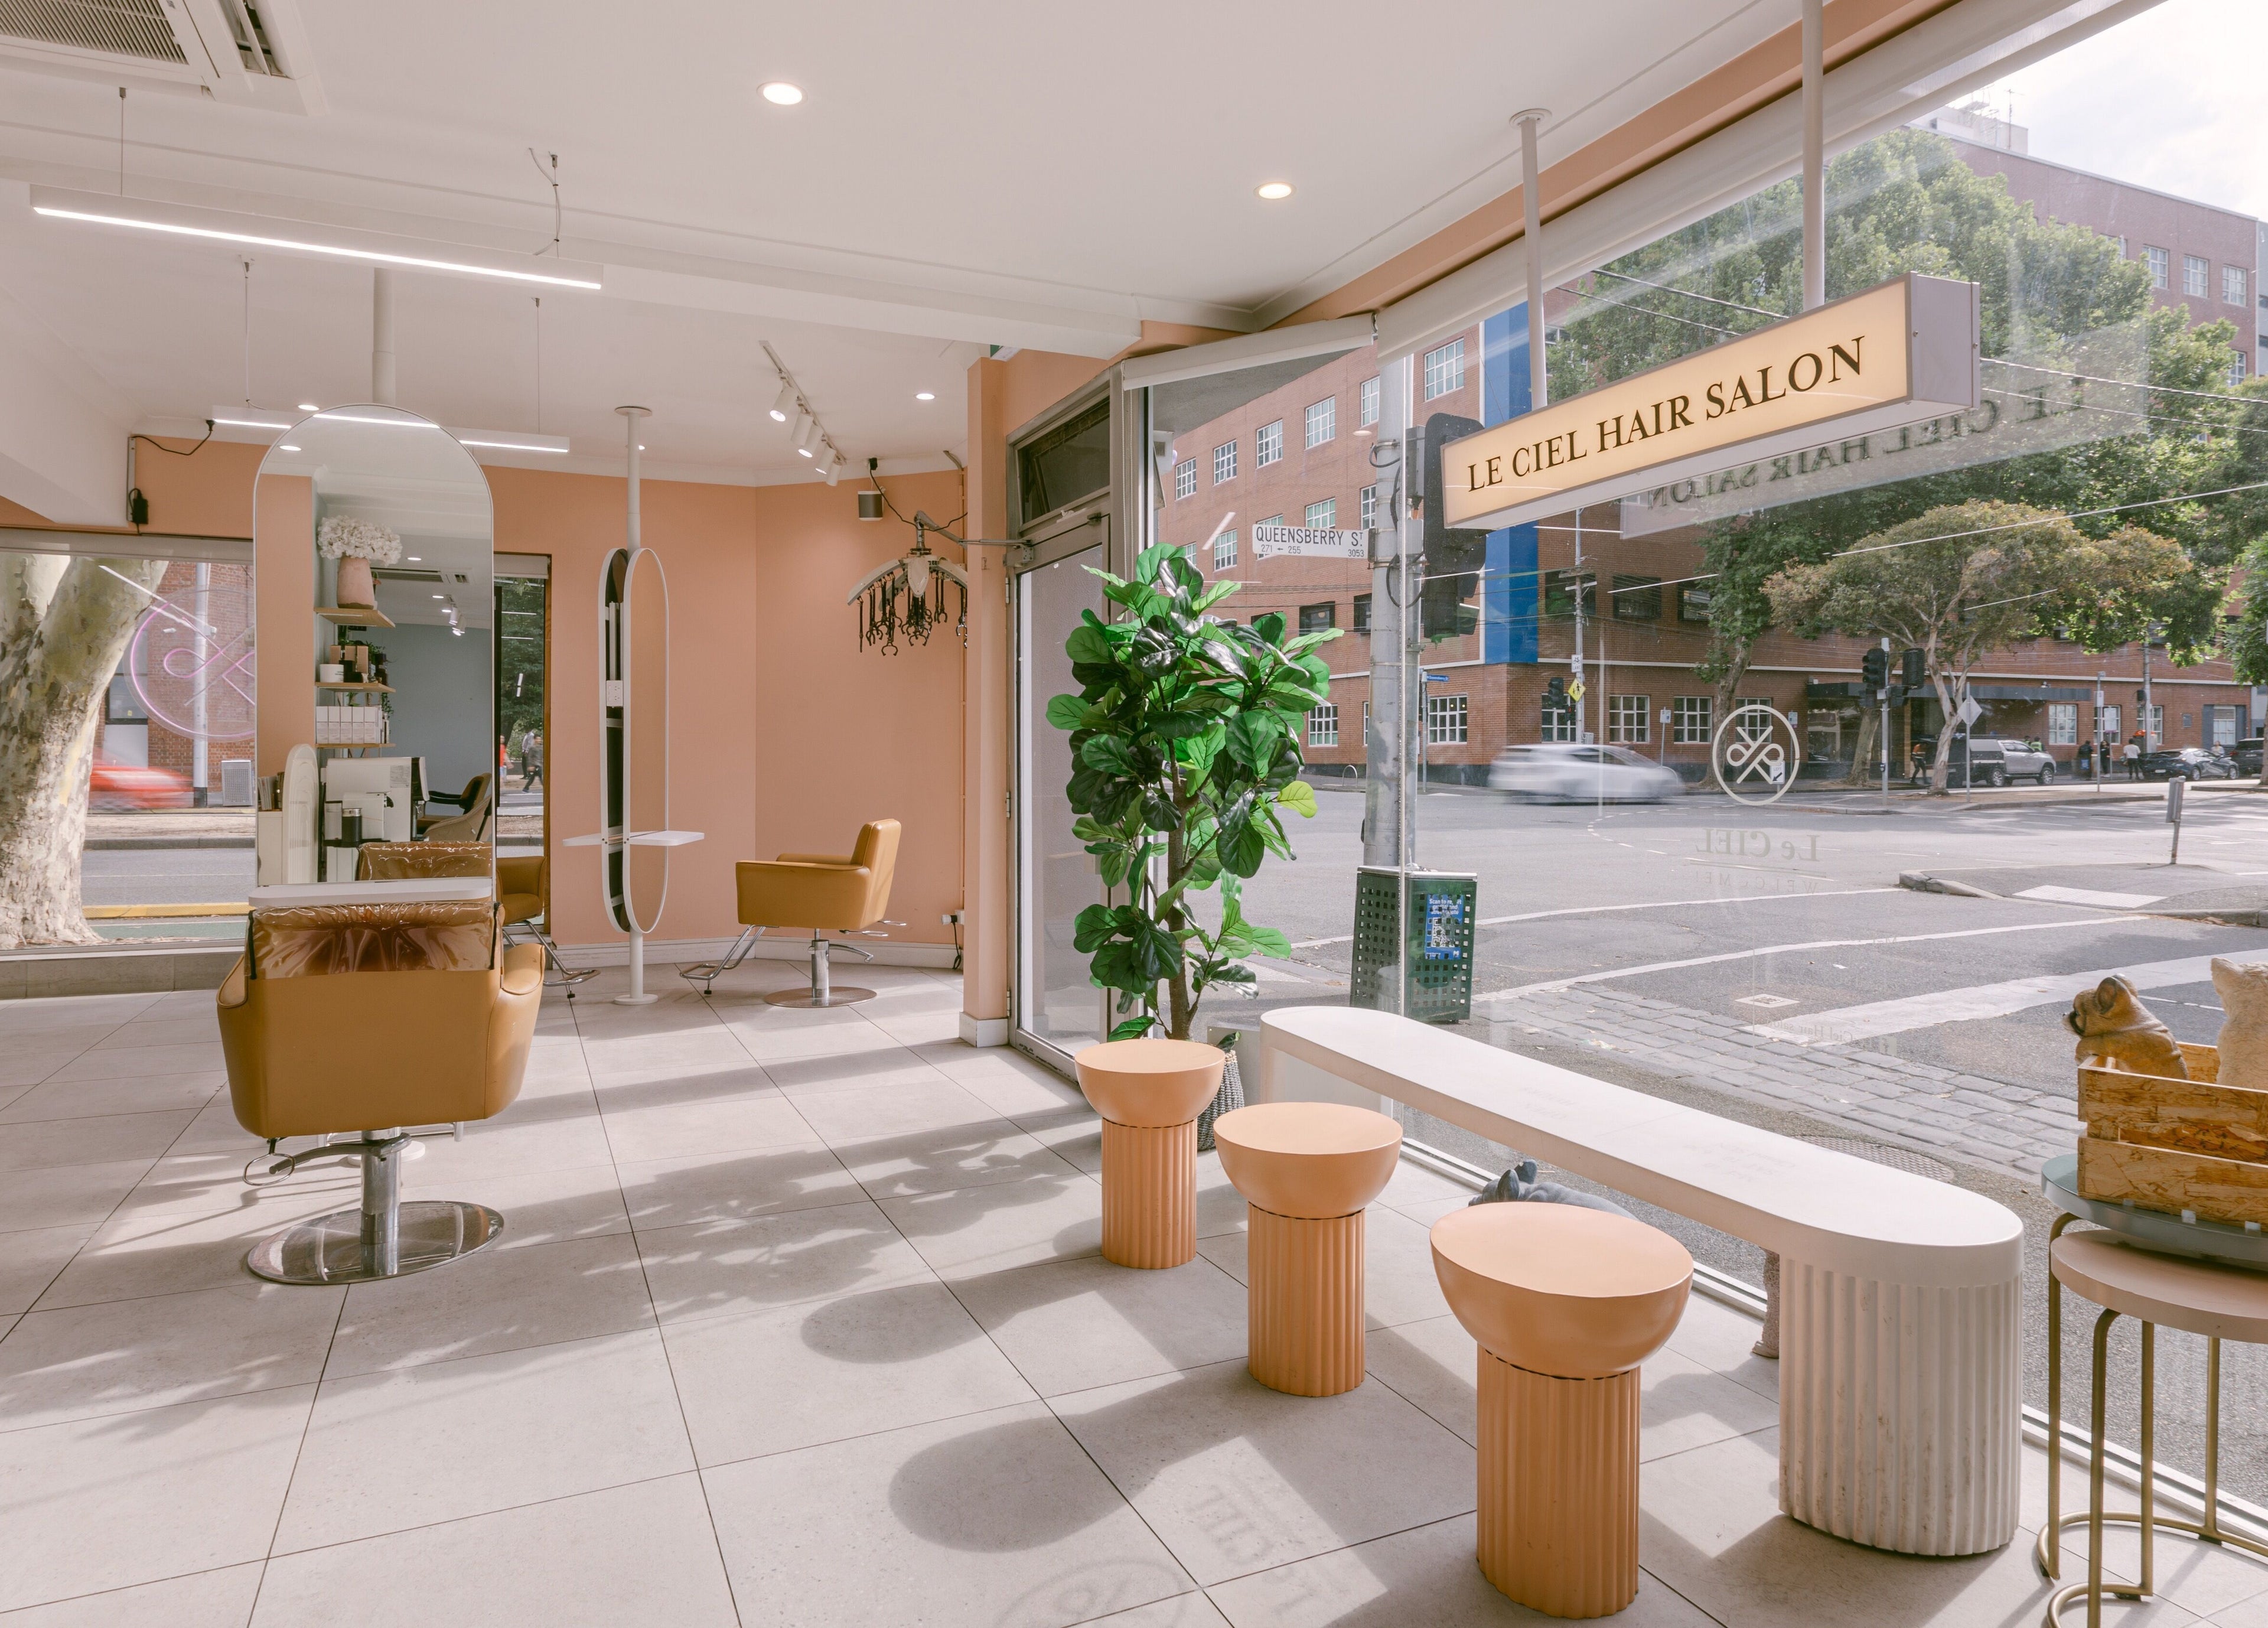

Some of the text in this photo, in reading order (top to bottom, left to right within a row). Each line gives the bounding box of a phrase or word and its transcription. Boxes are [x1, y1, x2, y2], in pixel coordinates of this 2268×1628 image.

[1467, 335, 1865, 492] LE CIEL HAIR SALON
[1256, 526, 1344, 546] QUEENSBERRY
[1261, 544, 1301, 554] 271 255
[1348, 549, 1364, 558] 3053
